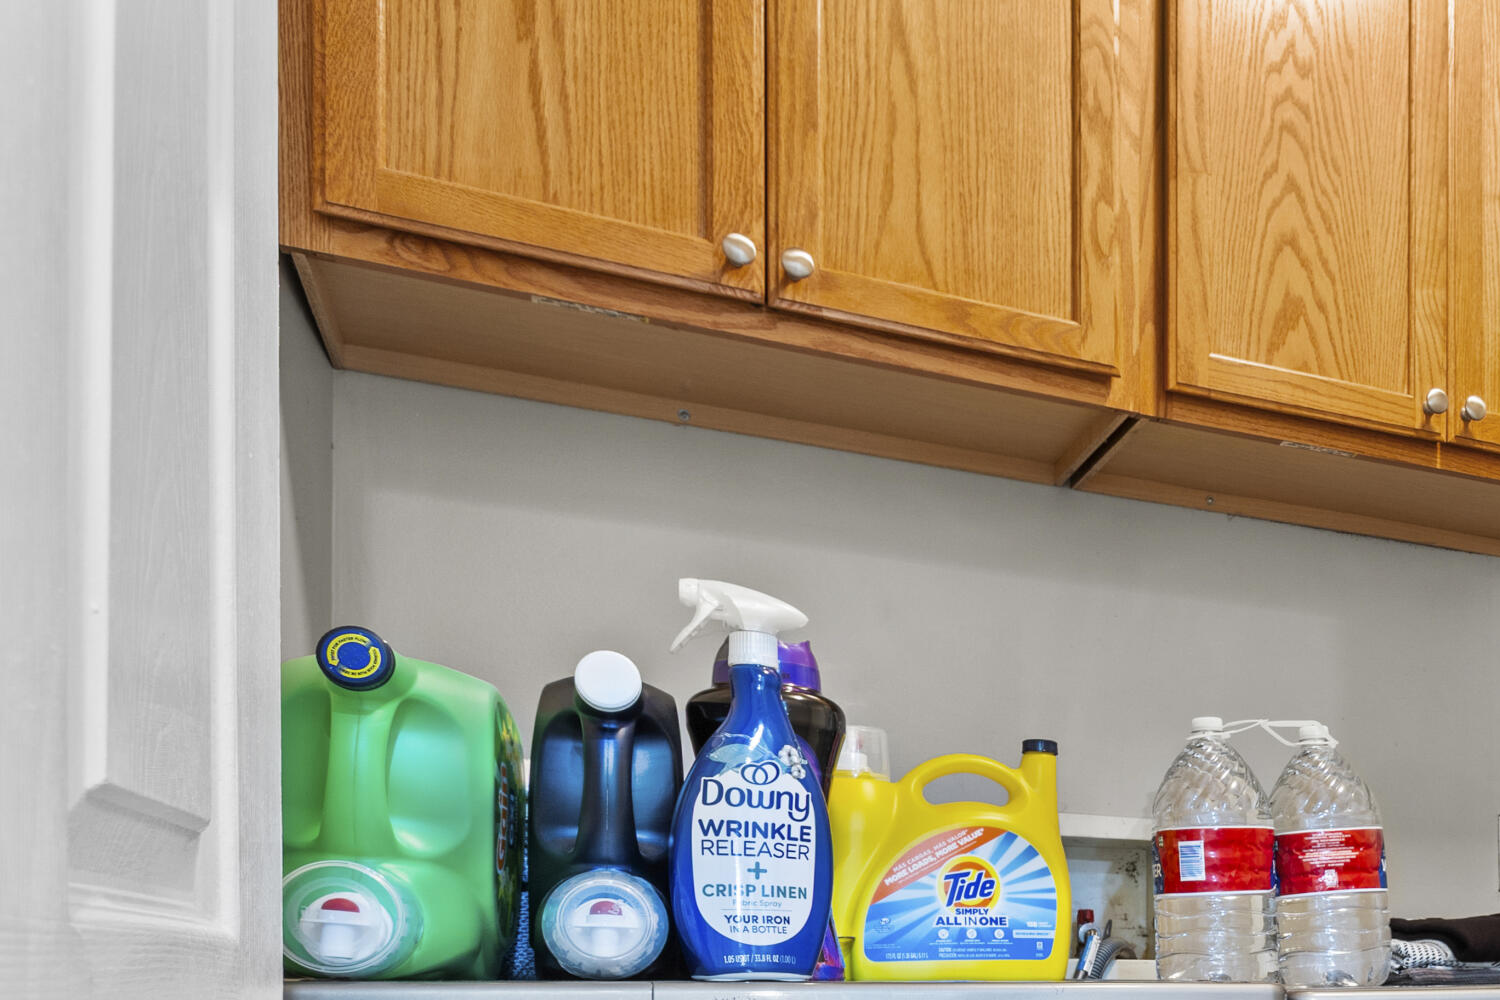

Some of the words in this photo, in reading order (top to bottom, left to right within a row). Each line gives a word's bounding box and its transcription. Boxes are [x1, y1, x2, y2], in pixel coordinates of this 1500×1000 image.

[701, 778, 811, 823] Downy
[698, 819, 812, 843] WRINKLE
[701, 839, 811, 861] RELEASER
[884, 869, 909, 887] MORE
[935, 842, 959, 862] MORE
[761, 885, 808, 900] LINEN
[943, 869, 996, 908] Tide
[732, 899, 758, 907] Fbric
[759, 900, 783, 908] Spray
[955, 908, 989, 916] SIMPLY
[762, 915, 791, 925] IRON
[729, 925, 740, 934] IN
[742, 925, 750, 934] A
[752, 926, 788, 935] BOTTLE
